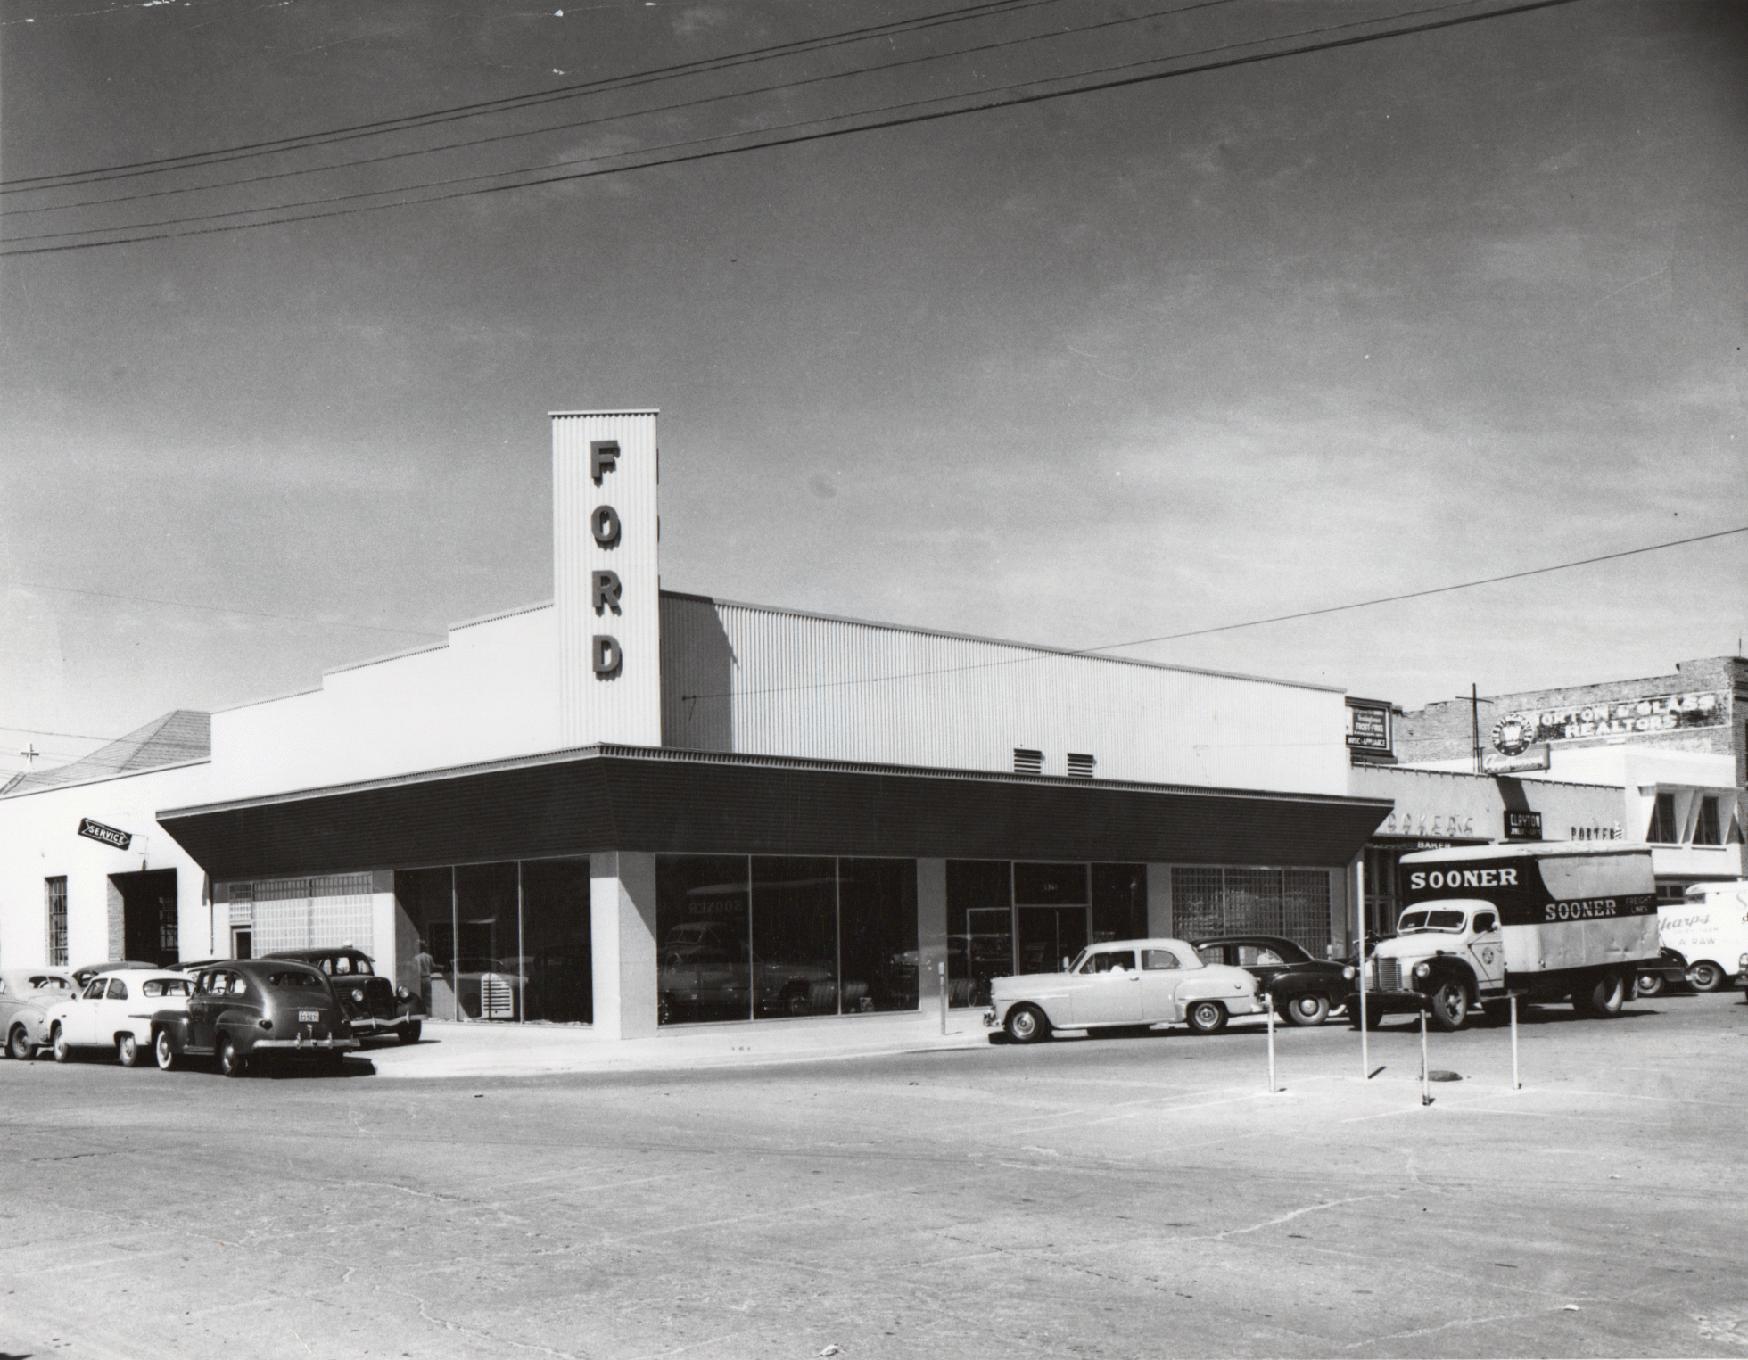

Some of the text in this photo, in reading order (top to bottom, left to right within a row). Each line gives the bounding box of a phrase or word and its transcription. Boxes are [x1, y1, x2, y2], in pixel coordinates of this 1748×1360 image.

[590, 440, 623, 677] FORD
[88, 825, 125, 846] SERVICE
[1410, 868, 1519, 889] SOONER
[1545, 899, 1617, 921] SOONER
